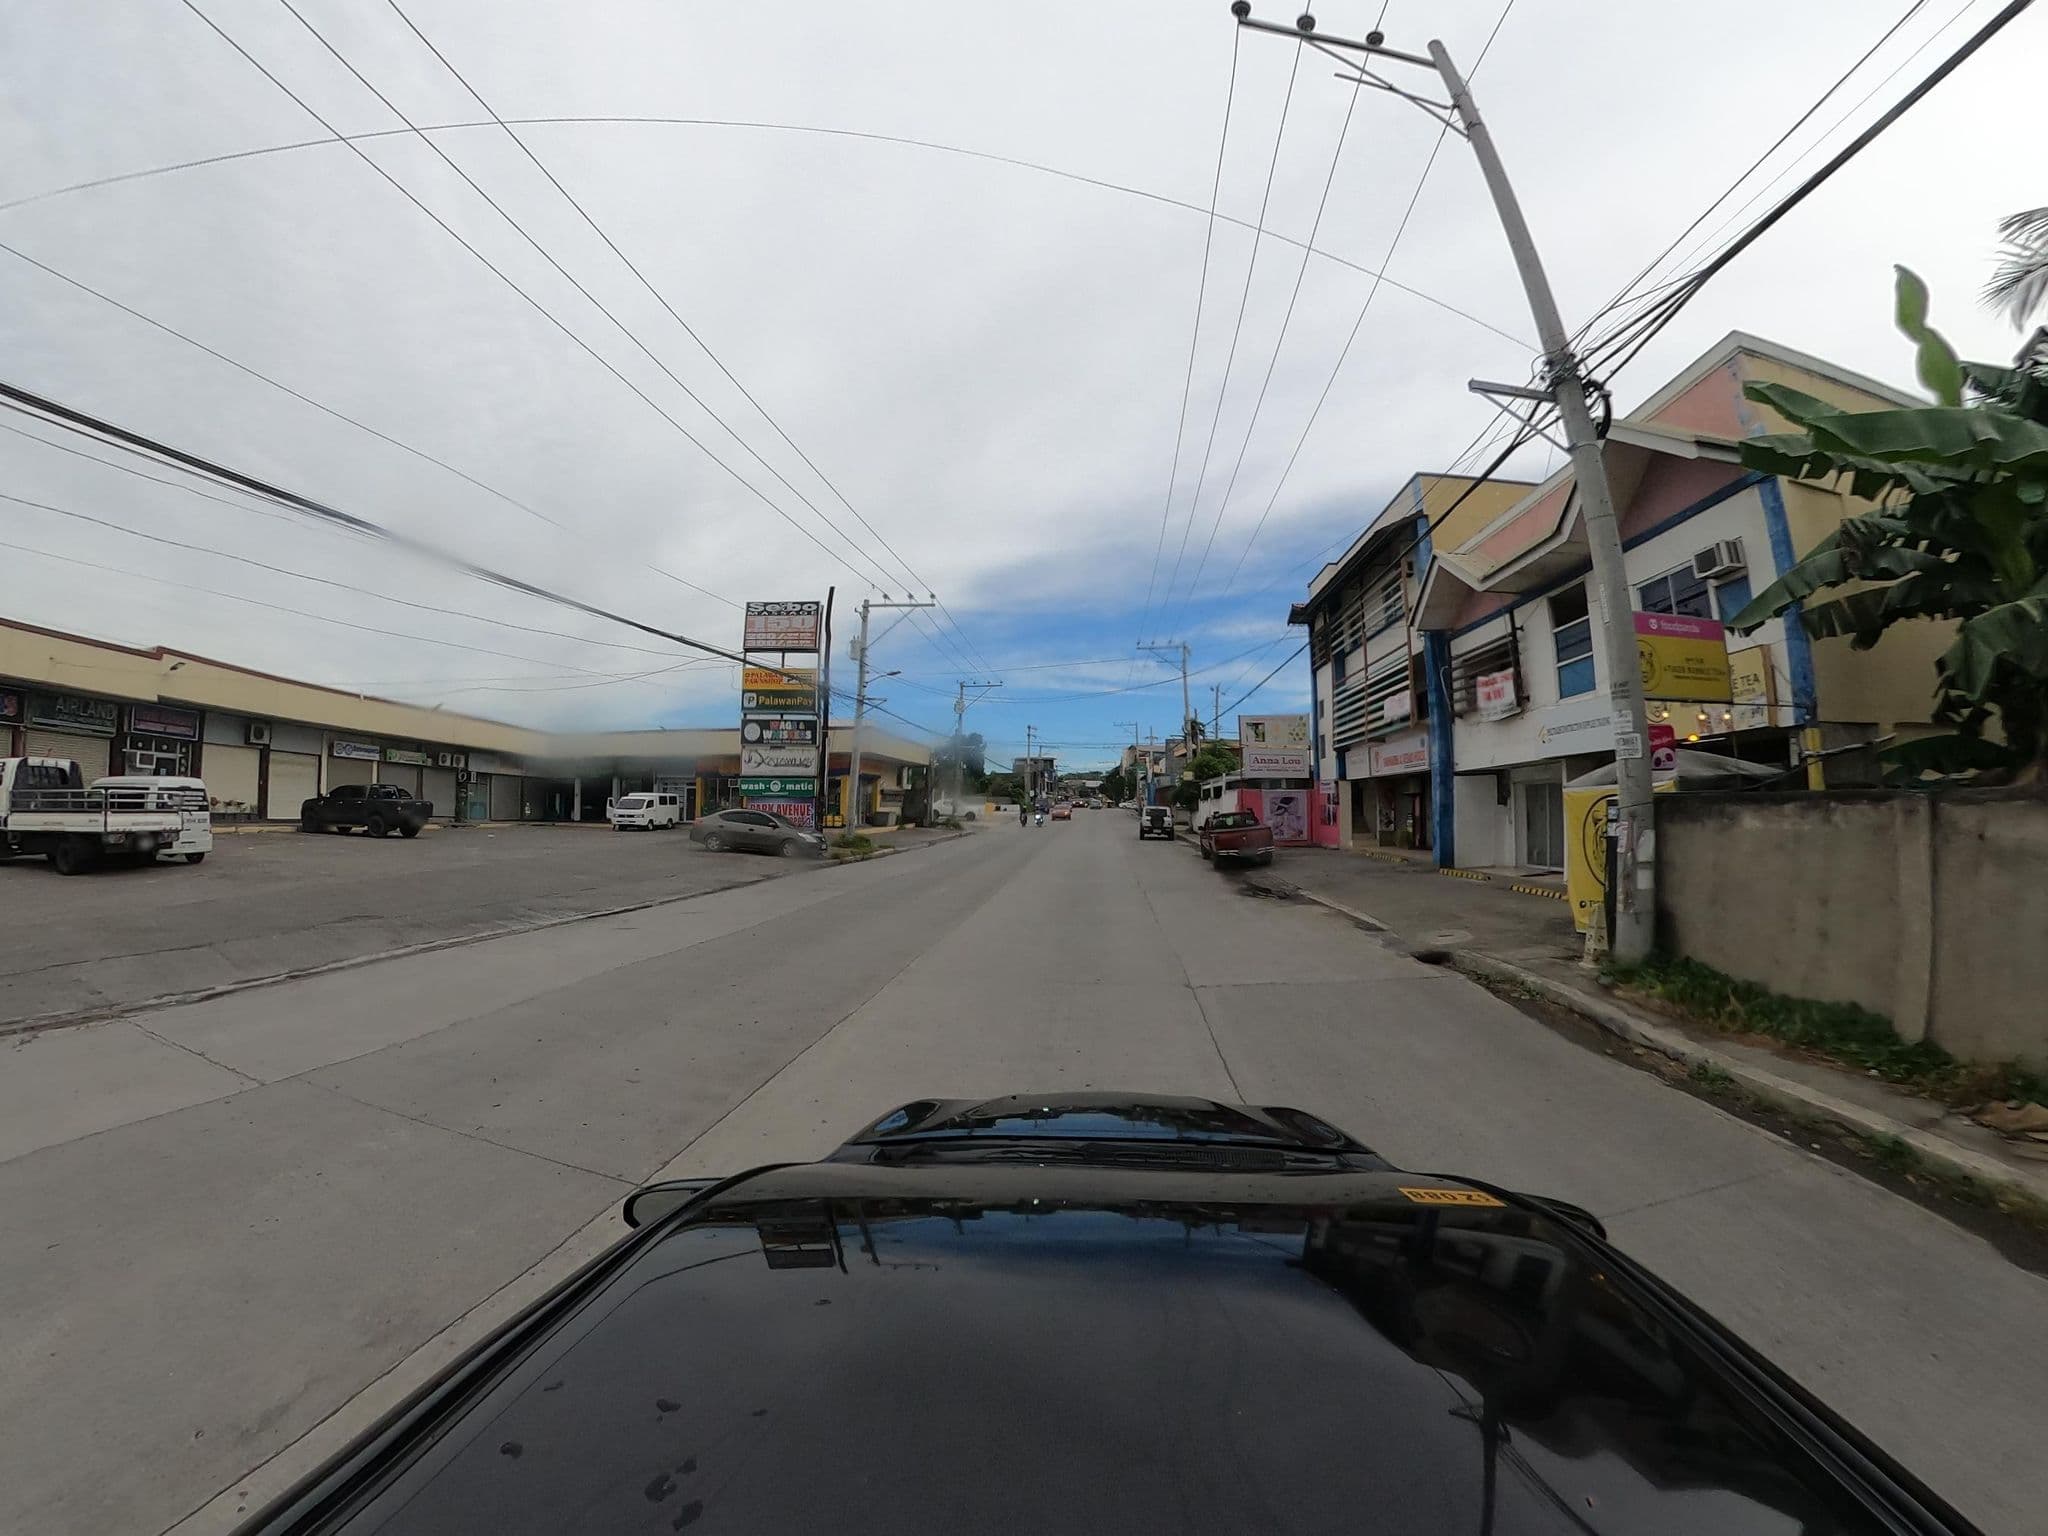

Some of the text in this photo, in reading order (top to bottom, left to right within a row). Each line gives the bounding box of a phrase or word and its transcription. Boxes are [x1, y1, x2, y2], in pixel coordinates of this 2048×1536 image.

[758, 696, 813, 706] PalawanPay
[1253, 756, 1301, 765] Anna Lou
[741, 782, 813, 790] wash matic
[777, 804, 811, 816] AVENUE
